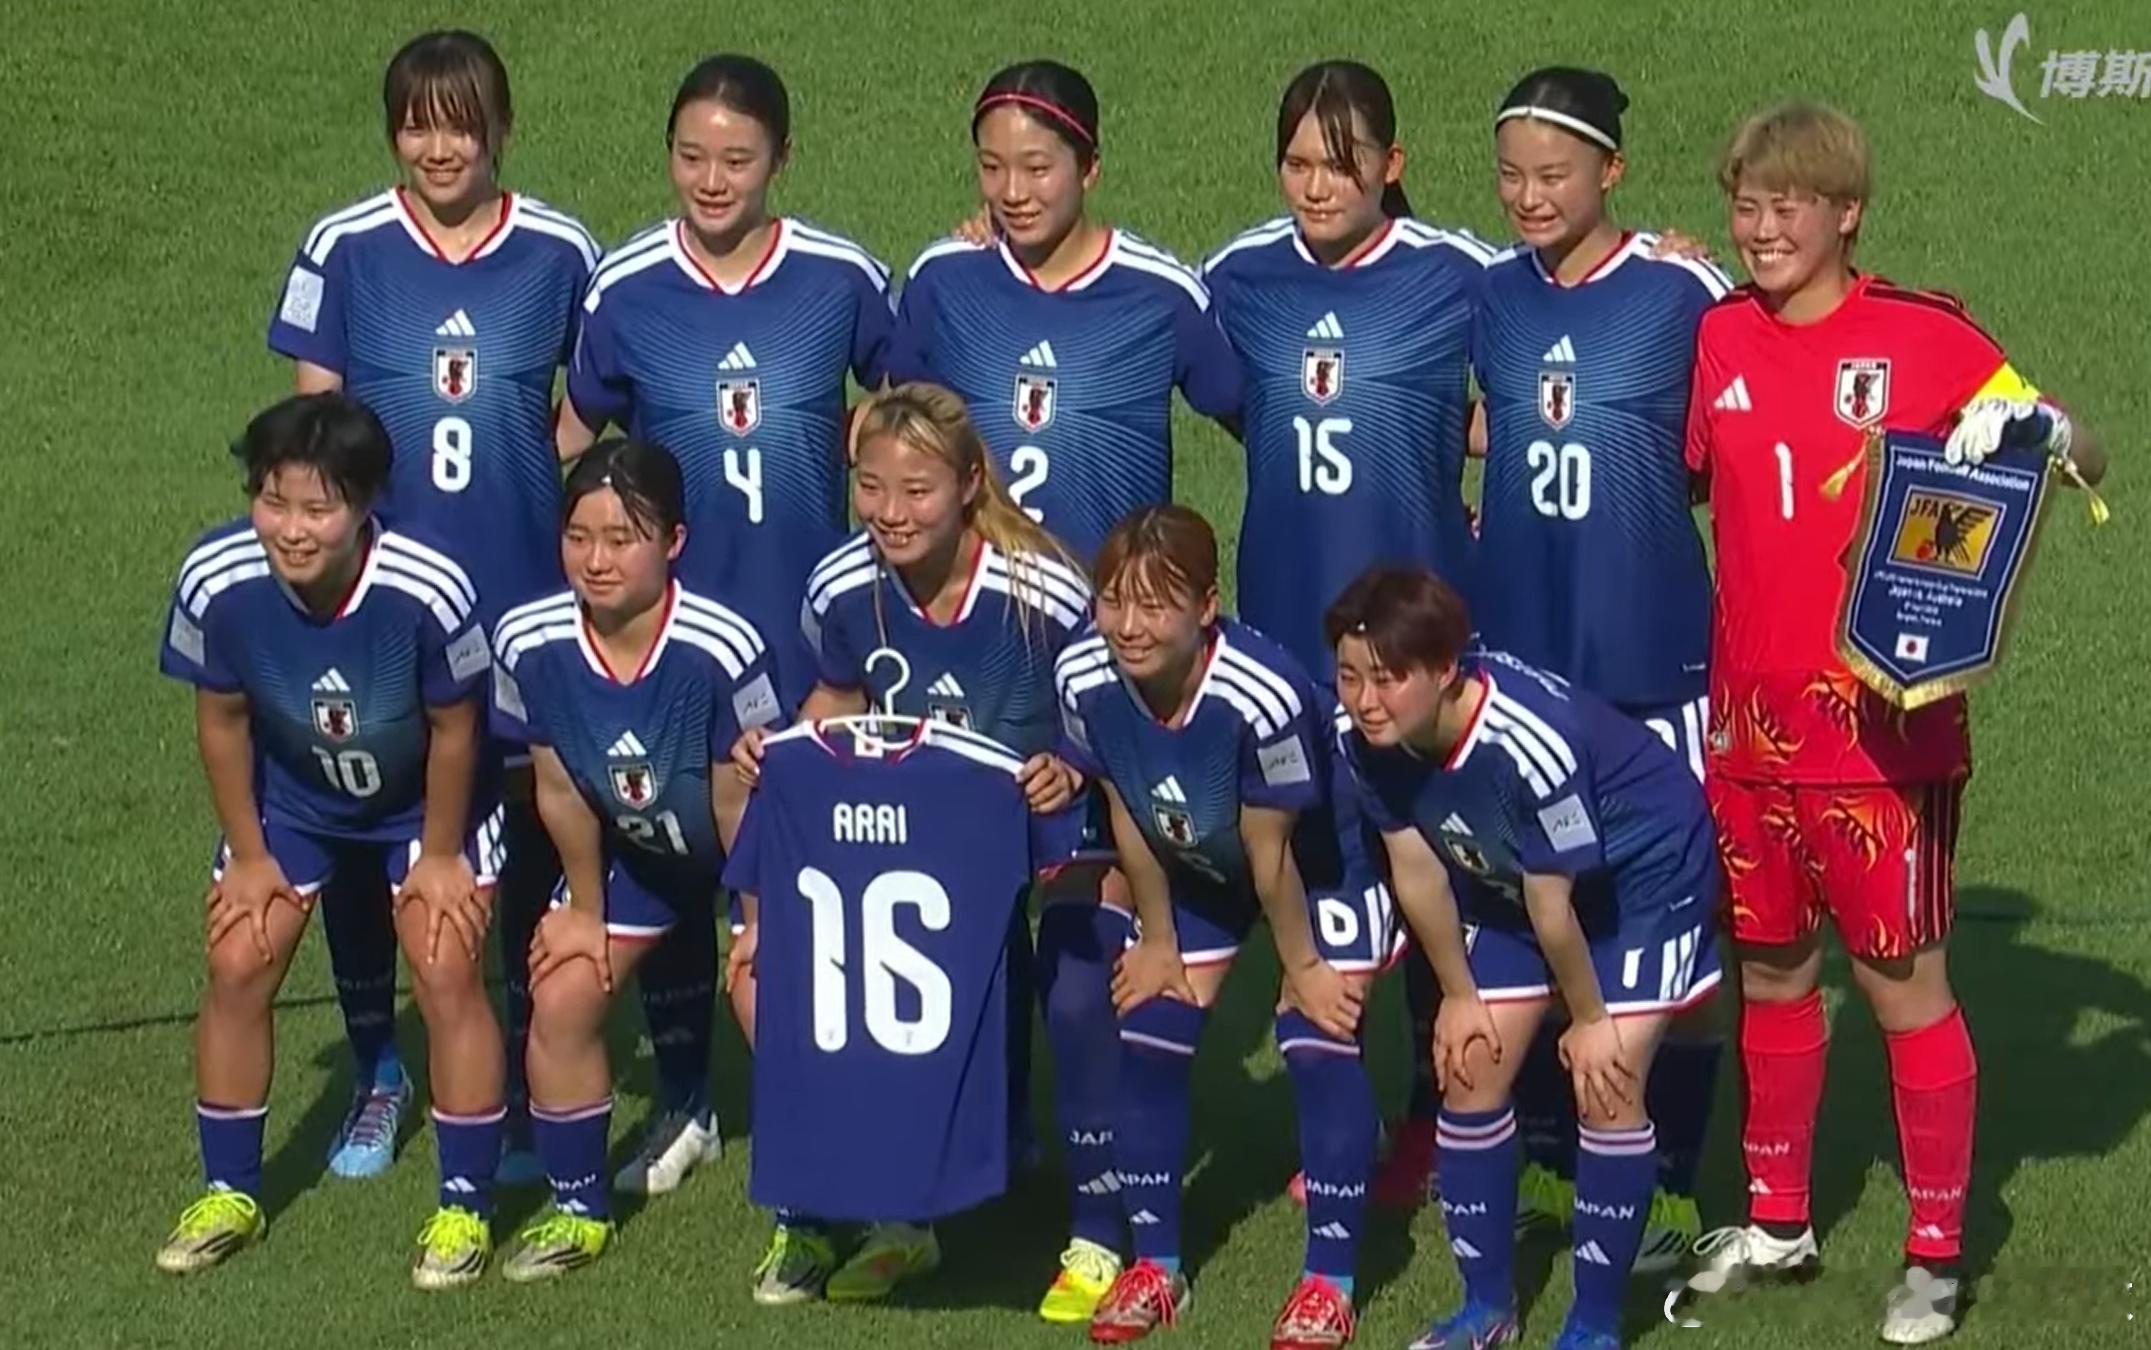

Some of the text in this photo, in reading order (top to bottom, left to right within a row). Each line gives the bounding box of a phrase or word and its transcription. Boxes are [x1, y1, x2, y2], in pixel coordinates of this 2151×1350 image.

[432, 416, 472, 493] 8
[723, 448, 763, 523] 4
[1008, 445, 1049, 523] 2
[1293, 416, 1353, 494] 15
[1526, 440, 1591, 520] 20
[1774, 441, 1794, 520] 1
[1910, 498, 1938, 517] JFA
[311, 744, 381, 797] 10
[616, 810, 689, 855] 21
[833, 801, 907, 845] ARAI
[798, 866, 951, 1055] 16
[1070, 1130, 1113, 1145] JAP
